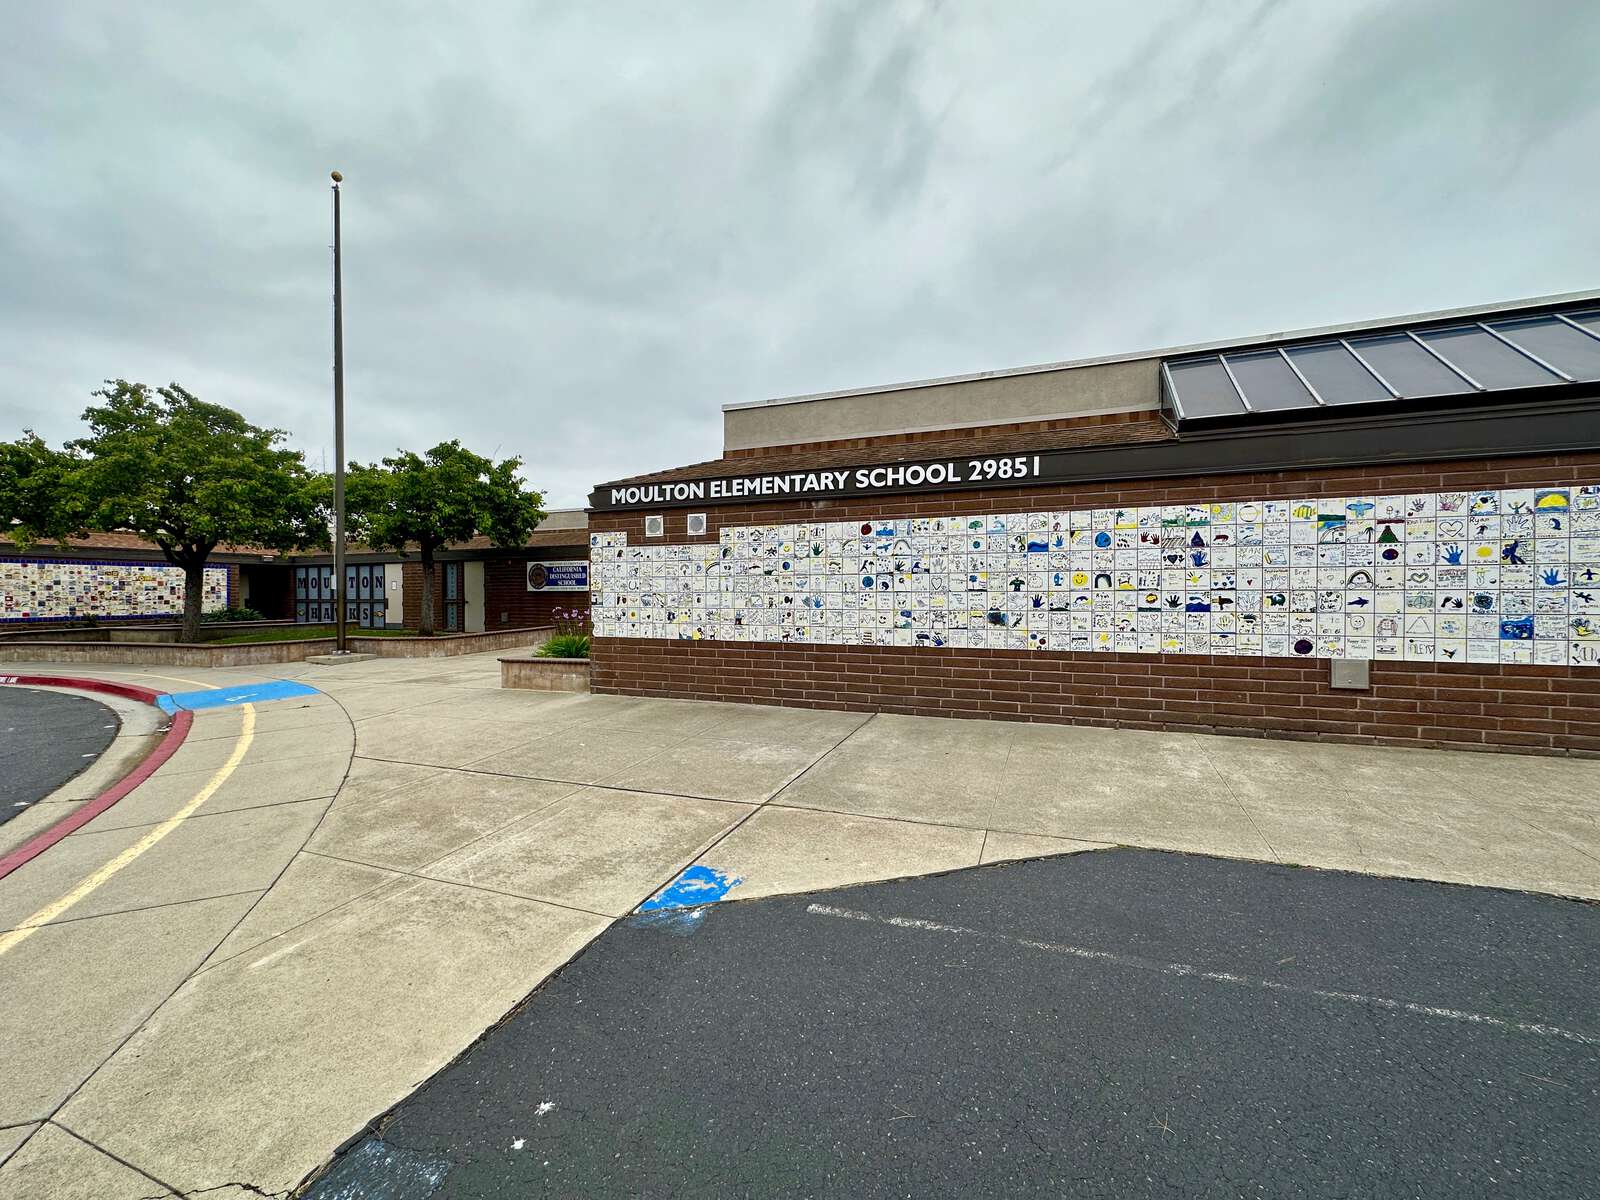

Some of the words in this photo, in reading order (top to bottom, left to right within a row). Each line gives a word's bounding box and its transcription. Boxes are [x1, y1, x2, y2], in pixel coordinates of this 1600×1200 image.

[611, 482, 704, 505] MOULTON
[710, 471, 849, 498] ELEMENTARY
[855, 463, 961, 488] SCHOOL
[968, 456, 1040, 481] 29851
[298, 576, 383, 589] MOUTON
[311, 607, 368, 620] HAKS
